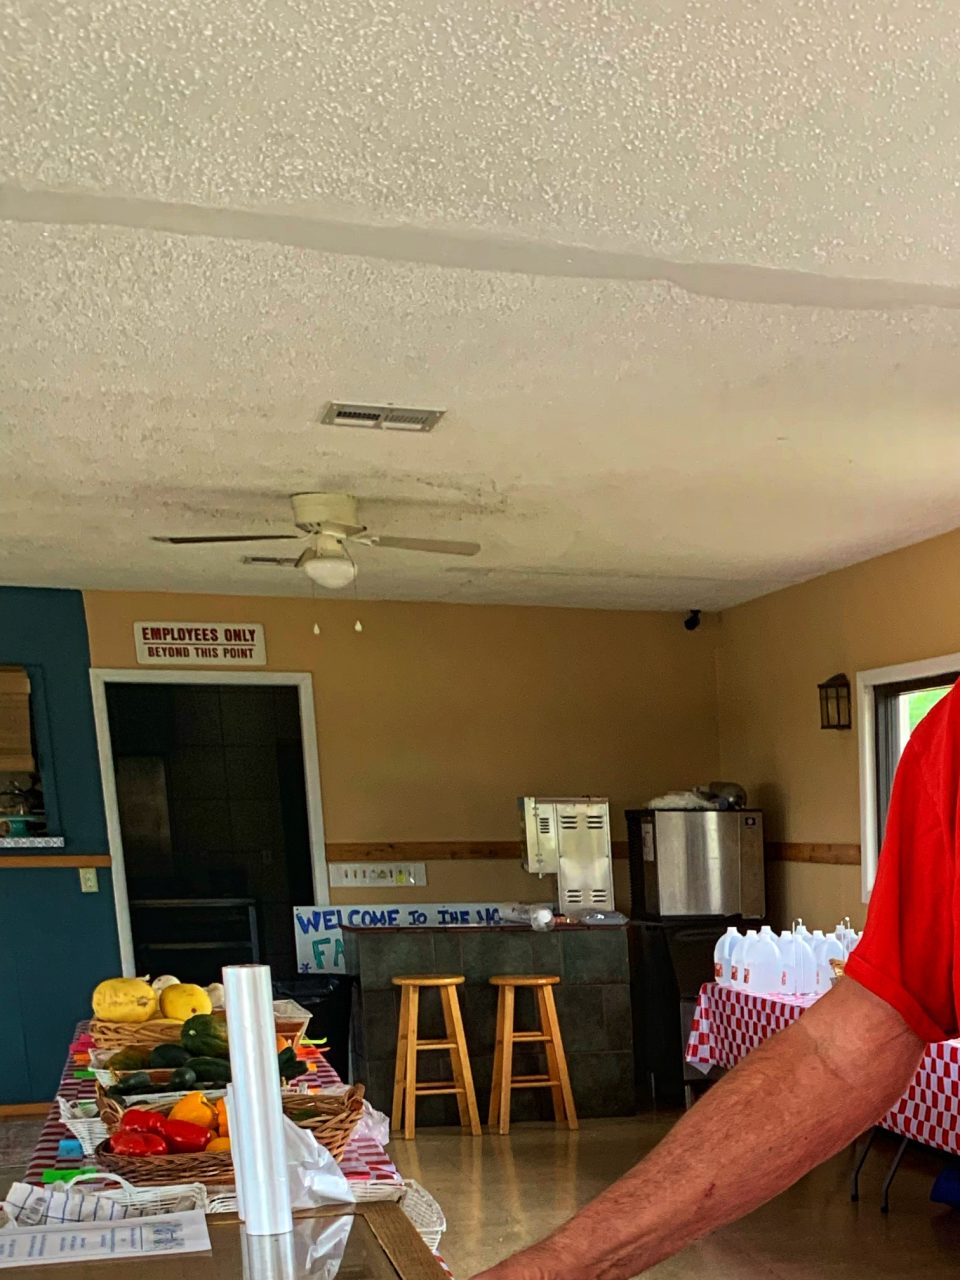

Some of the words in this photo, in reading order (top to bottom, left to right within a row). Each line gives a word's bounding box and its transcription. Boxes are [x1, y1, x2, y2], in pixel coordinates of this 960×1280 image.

[142, 627, 218, 641] EMPLOYEES
[224, 629, 256, 642] ONLY
[148, 646, 190, 657] BEYOND
[194, 647, 219, 658] THIS
[223, 648, 254, 659] POINT
[296, 909, 399, 935] WELCOME
